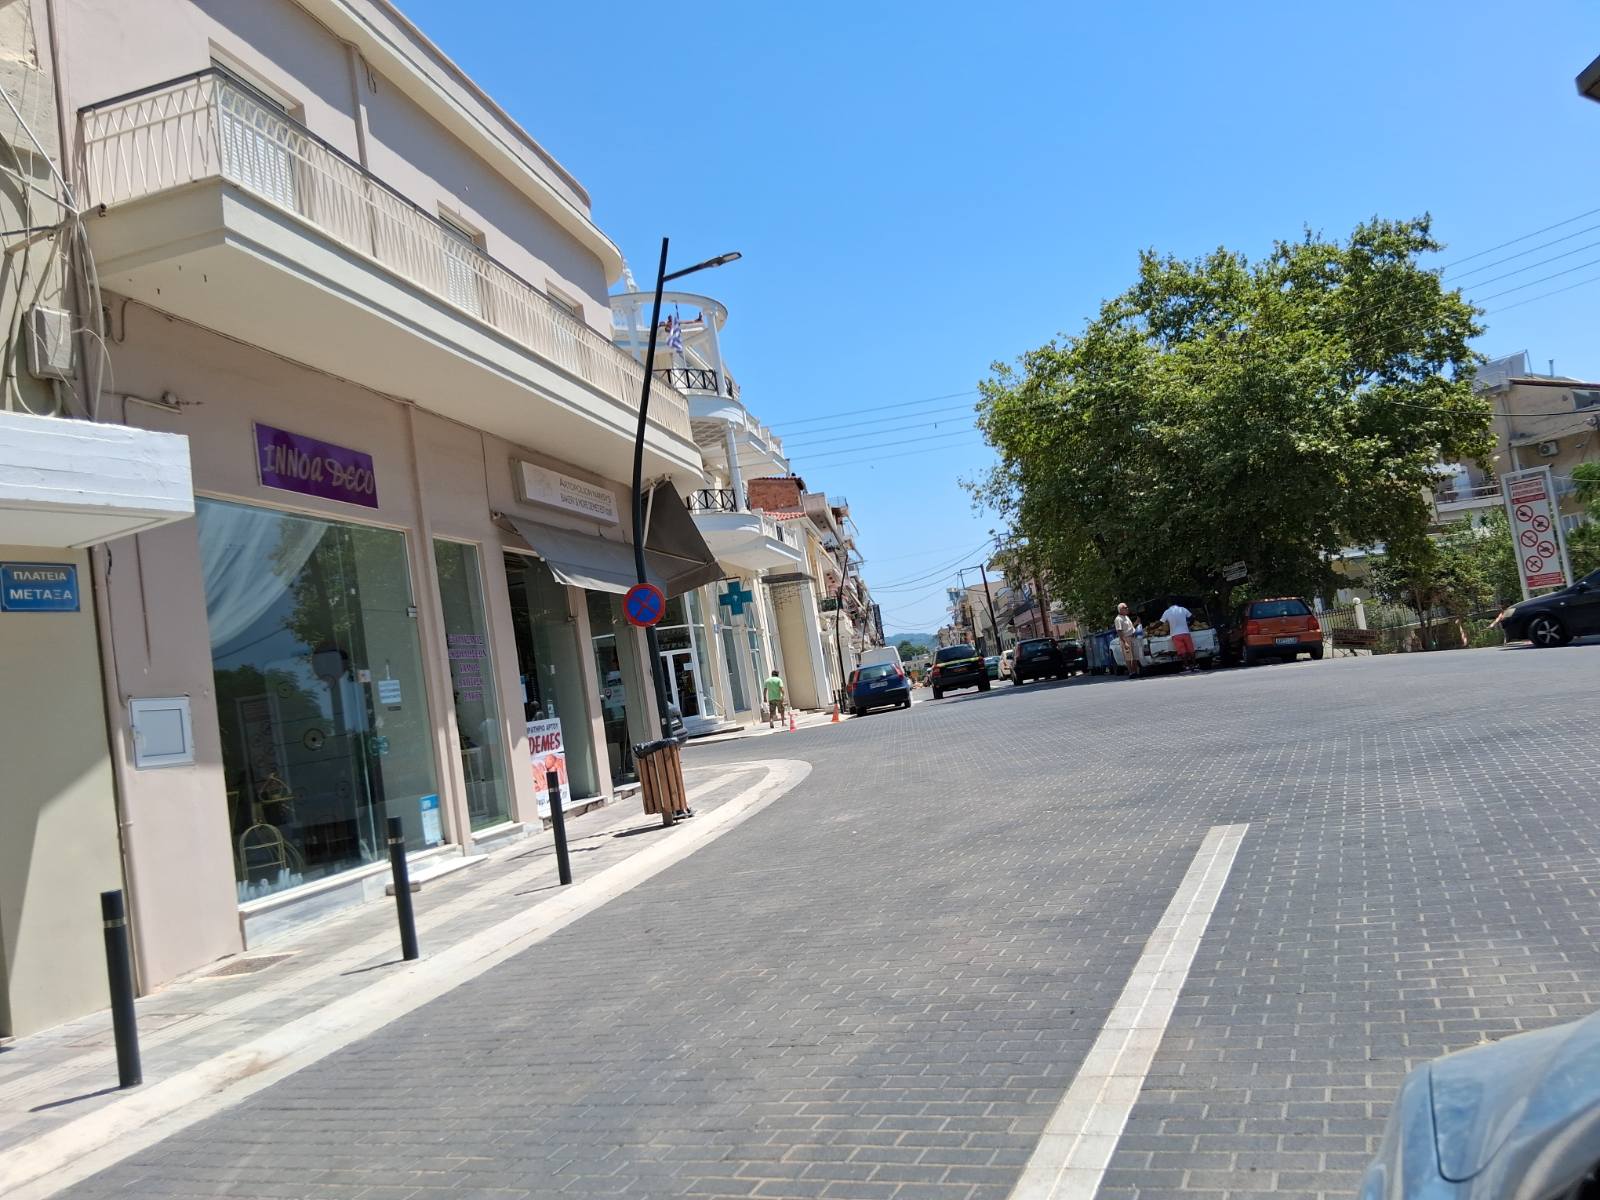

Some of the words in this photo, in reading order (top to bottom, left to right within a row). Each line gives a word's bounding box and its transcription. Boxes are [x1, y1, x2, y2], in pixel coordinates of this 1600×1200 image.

[13, 571, 67, 580] ΠΛΑΤΕΙΑ
[9, 588, 73, 600] ΜΕΤΑΞΑ
[528, 732, 560, 754] DEMES
